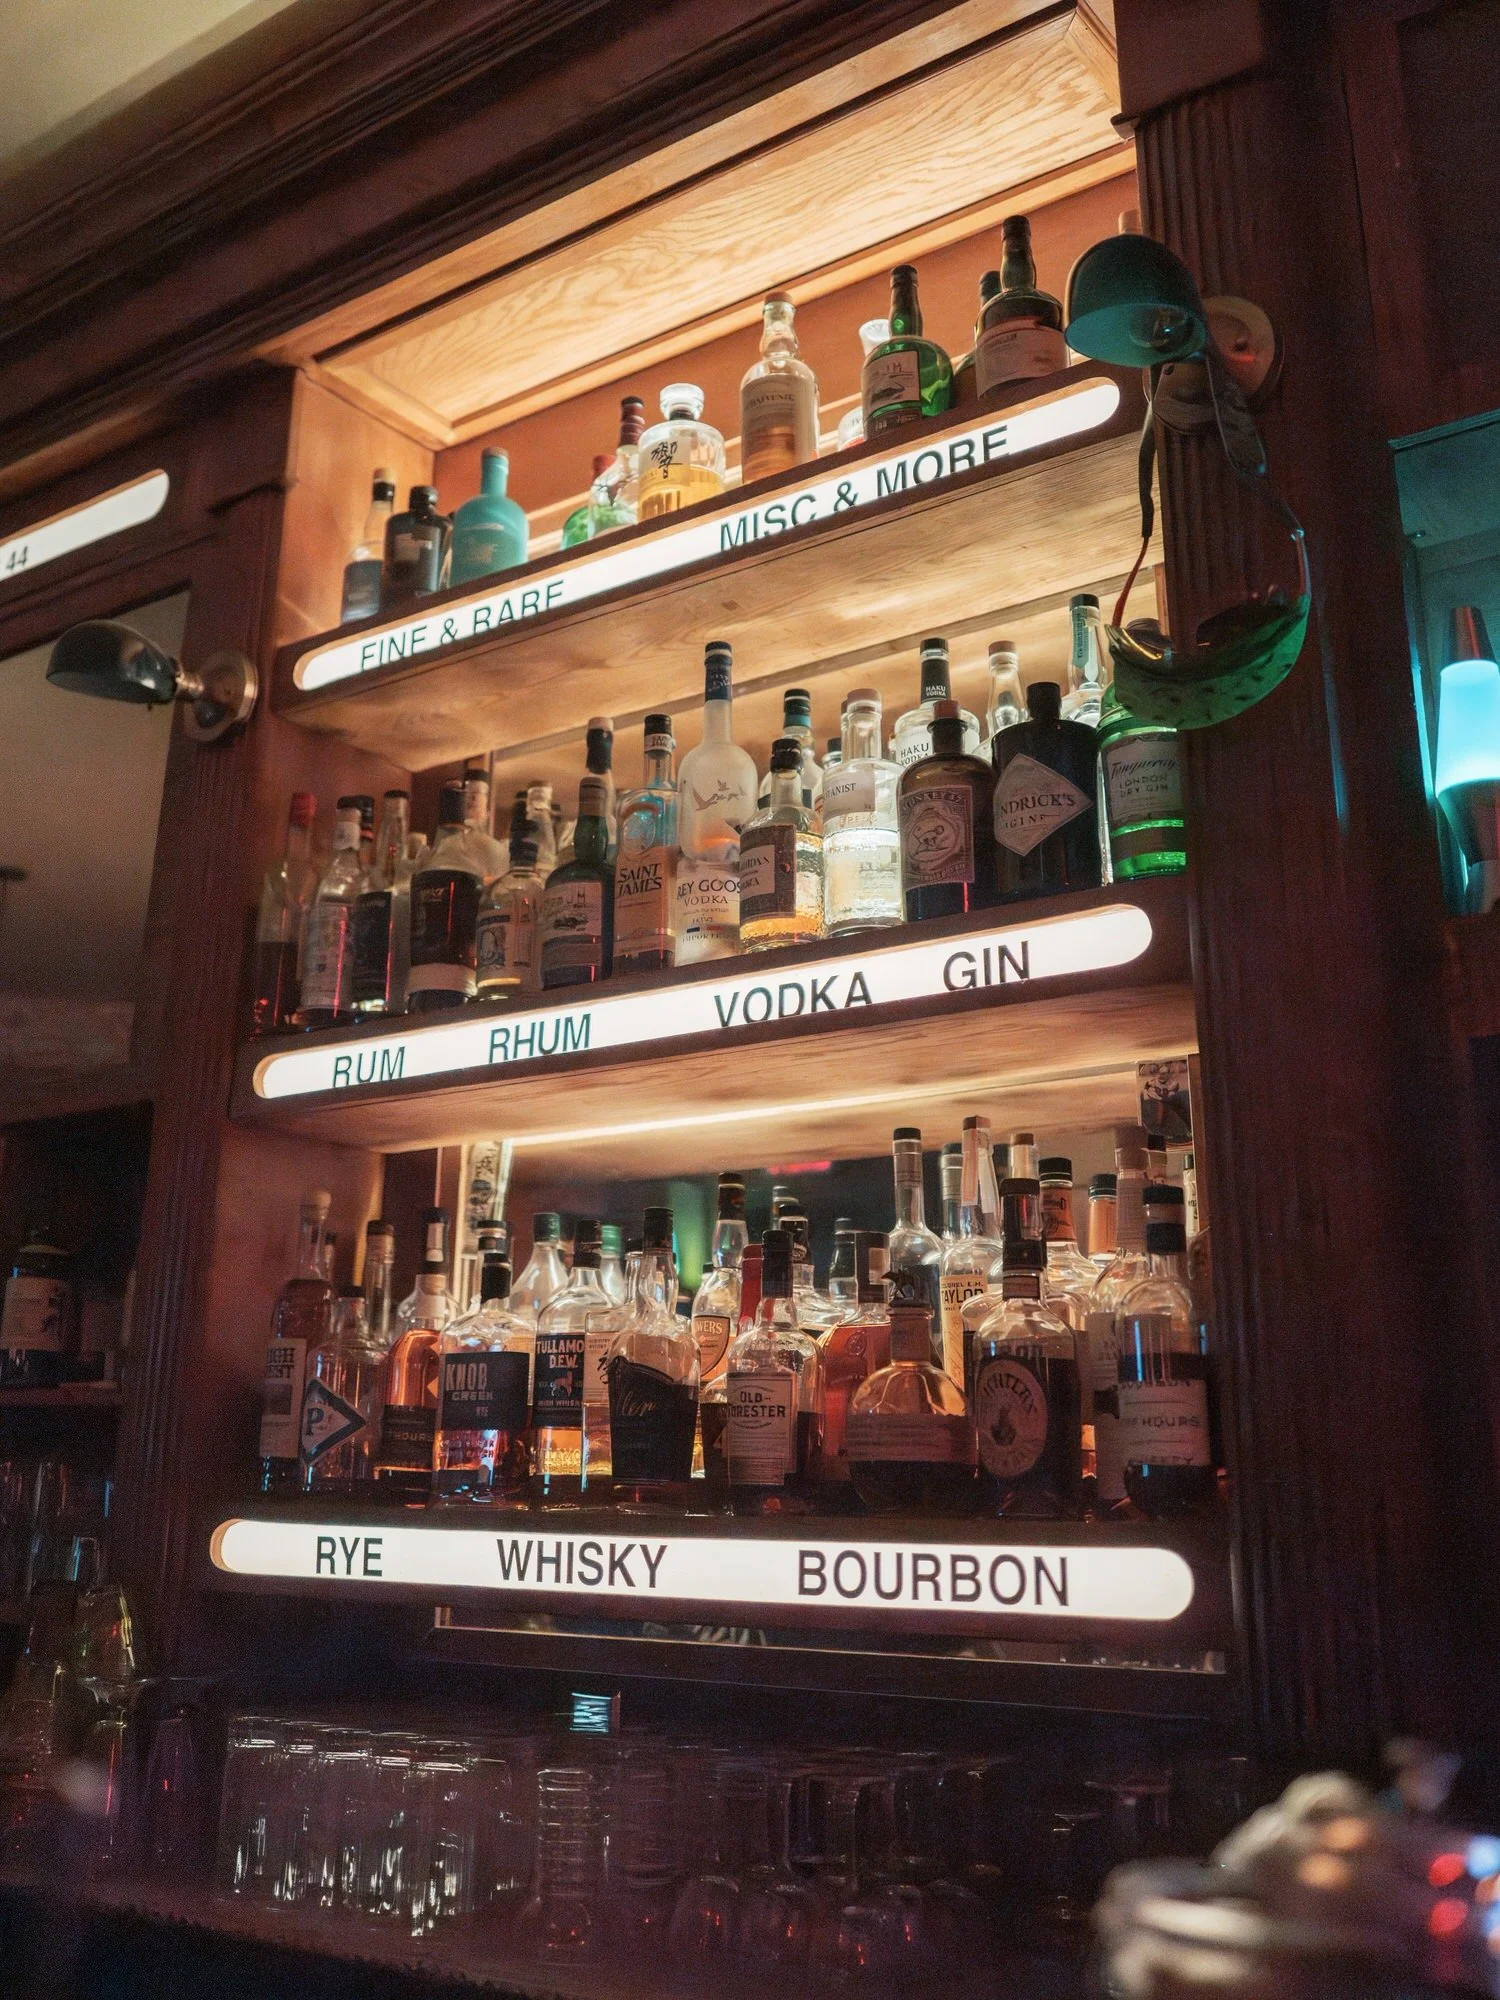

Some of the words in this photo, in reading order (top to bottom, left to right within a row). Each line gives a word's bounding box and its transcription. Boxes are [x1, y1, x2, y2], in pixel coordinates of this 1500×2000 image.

[720, 494, 816, 552] MISC
[833, 481, 859, 514] &
[876, 424, 1008, 499] MORE
[6, 544, 28, 571] 44
[361, 625, 427, 671] FINE
[440, 617, 458, 645] &
[473, 579, 564, 635] RARE
[900, 742, 929, 758] HAKU
[1119, 774, 1168, 789] LONDON
[1120, 787, 1140, 798] DRY
[1146, 783, 1169, 792] GIN
[1000, 794, 1075, 815] NDRICK'S
[616, 863, 660, 883] SAINT
[616, 877, 662, 898] JAMES
[677, 881, 695, 900] REY
[698, 879, 740, 894] GOOS
[683, 895, 729, 907] VODKA
[332, 1046, 406, 1088] RUM
[488, 1013, 592, 1064] RHUM
[714, 971, 873, 1028] VODKA
[943, 940, 1030, 993] GIN
[696, 1320, 723, 1334] WERS
[537, 1339, 585, 1354] TULLAMO
[446, 1363, 488, 1392] KNOB
[451, 1391, 494, 1401] CREEK
[740, 1391, 763, 1403] OLD
[315, 1536, 383, 1577] RYE
[496, 1538, 668, 1588] WHISKY
[797, 1549, 1070, 1607] BOURBON
